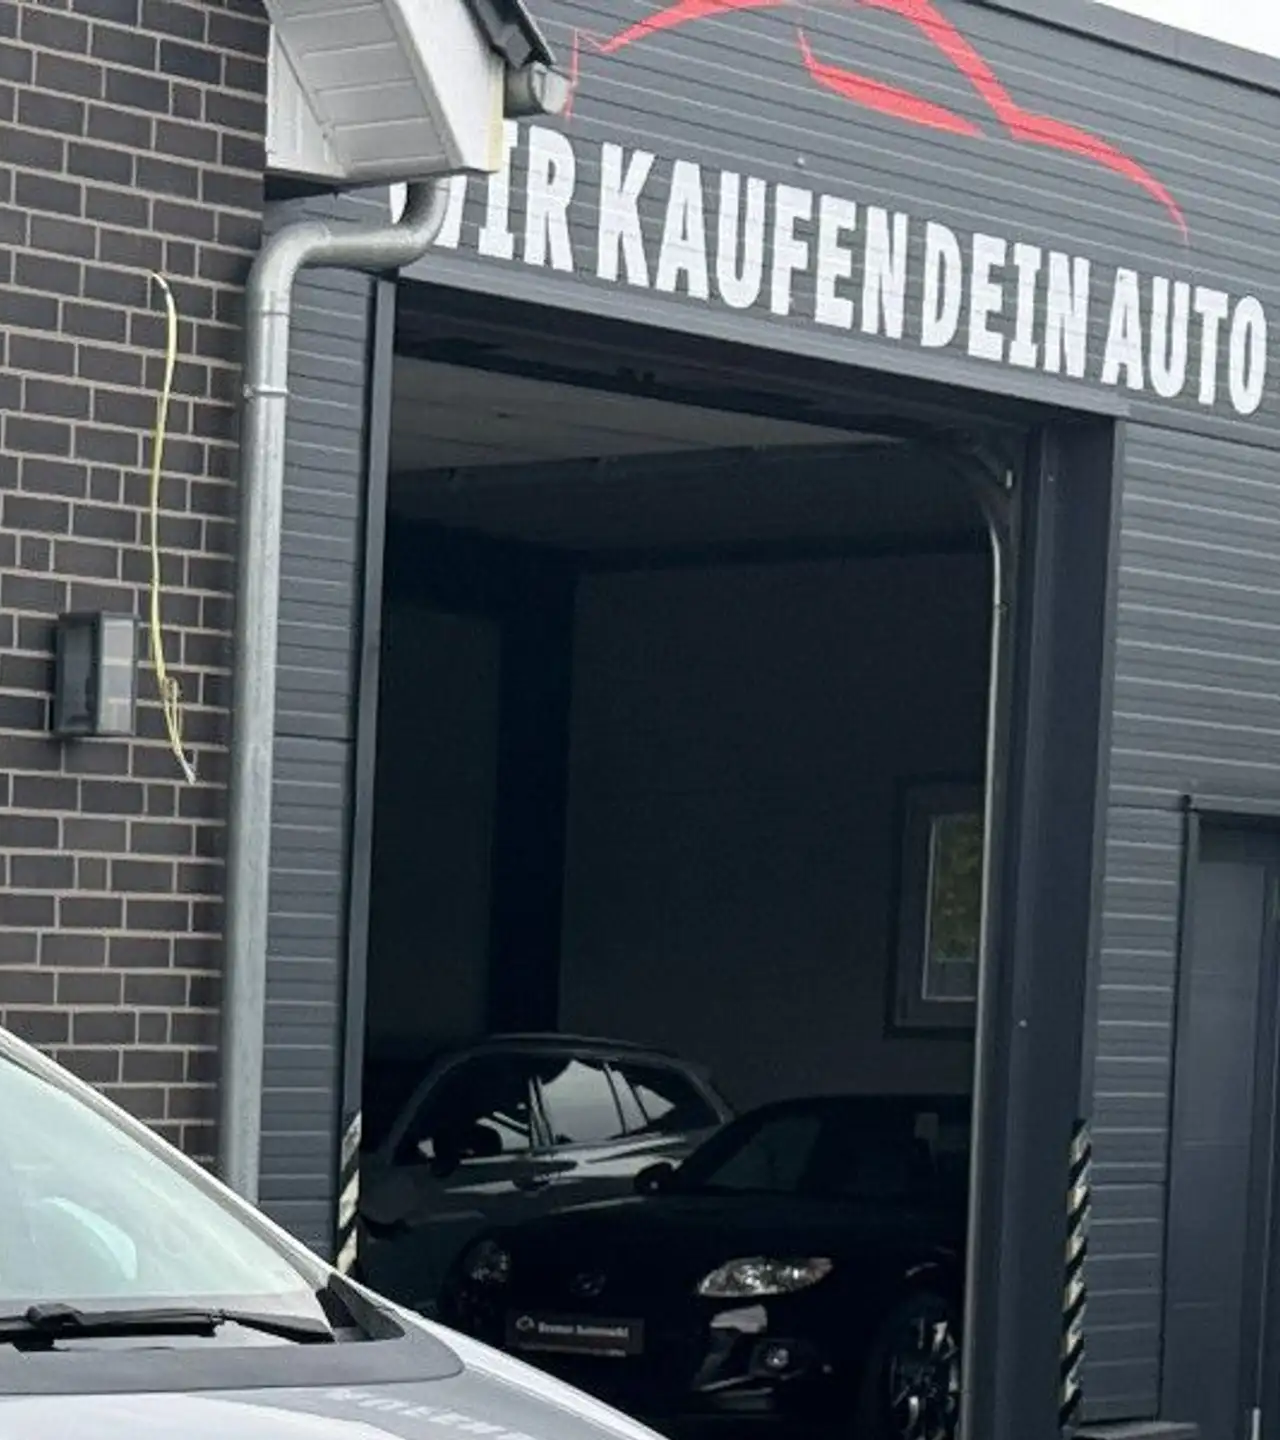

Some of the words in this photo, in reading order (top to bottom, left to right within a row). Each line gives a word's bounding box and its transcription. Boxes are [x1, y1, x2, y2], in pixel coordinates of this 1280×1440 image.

[389, 119, 577, 273] IR
[595, 141, 908, 340] KAUFEN
[920, 220, 1091, 379] DEIN
[1101, 266, 1268, 416] AUTO
